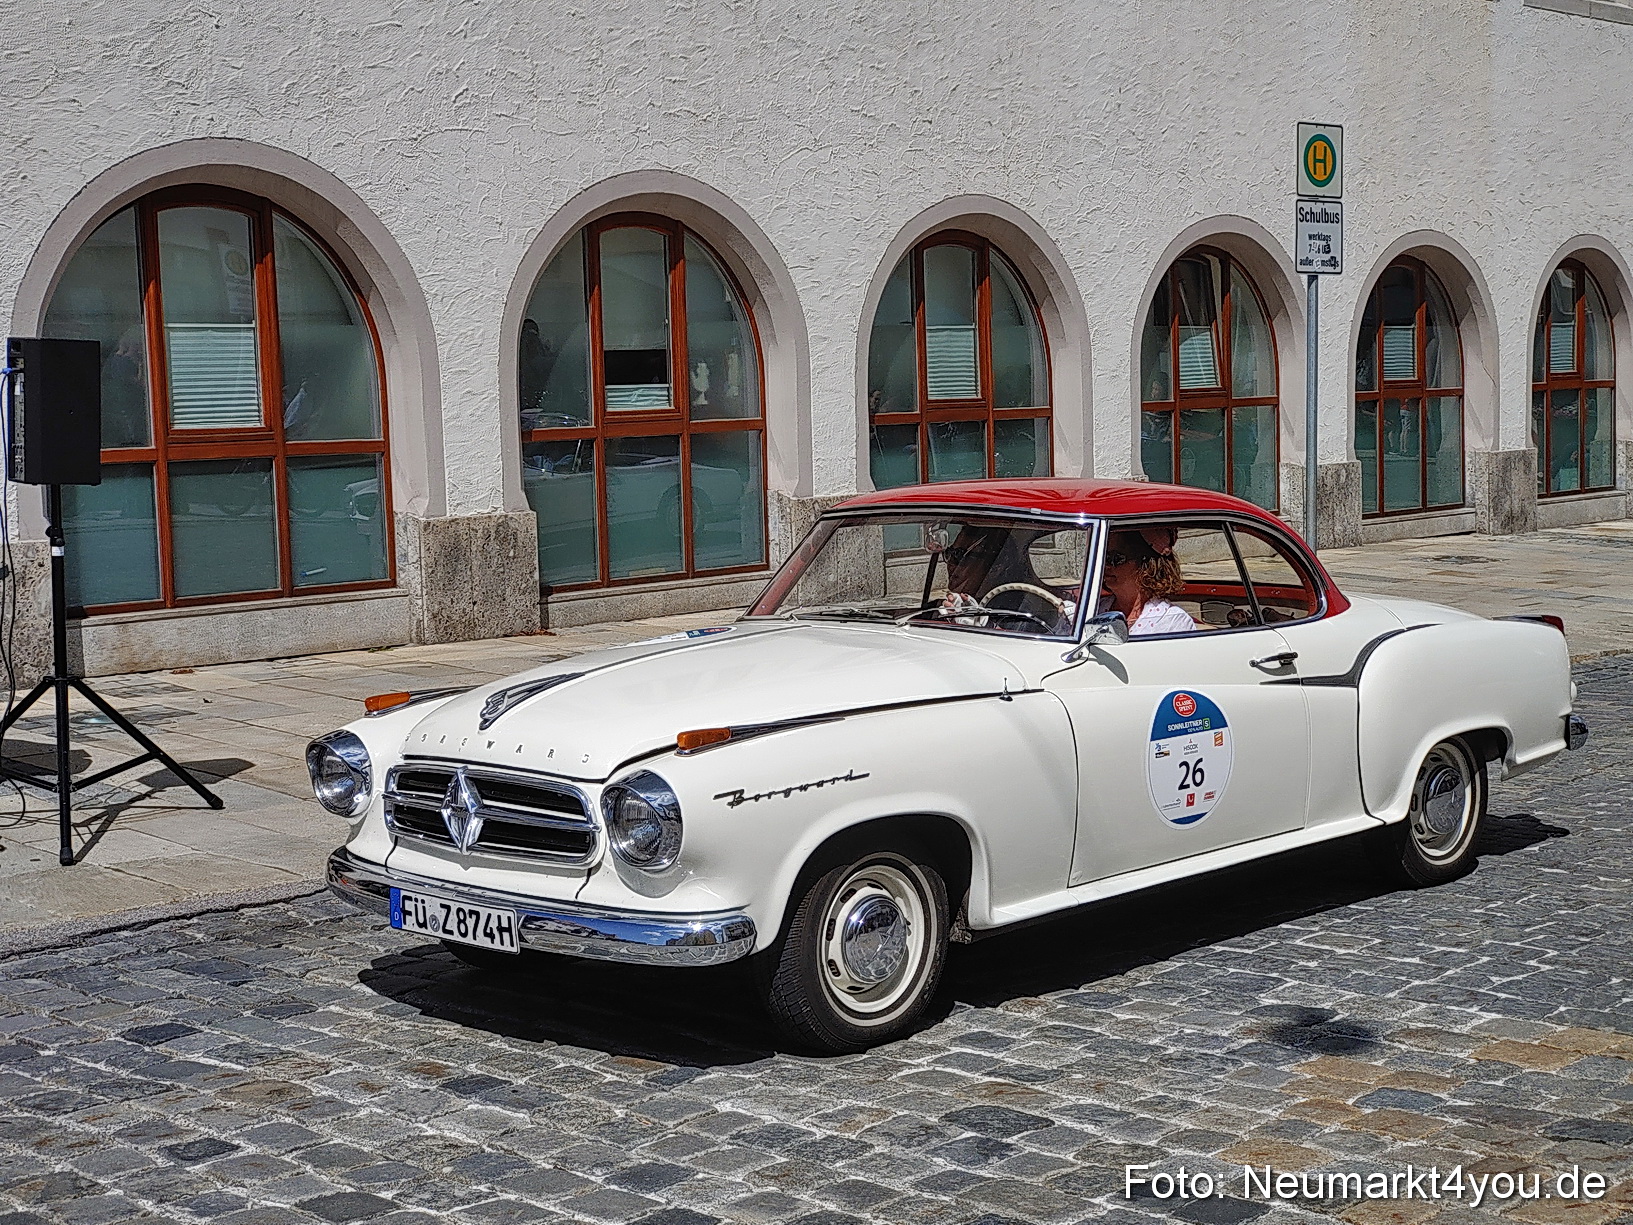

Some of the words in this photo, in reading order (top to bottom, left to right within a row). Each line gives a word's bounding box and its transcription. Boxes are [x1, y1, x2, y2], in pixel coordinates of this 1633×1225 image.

[1313, 145, 1328, 176] H
[1299, 206, 1340, 224] Schulbus
[1308, 231, 1332, 244] werktags
[1299, 256, 1314, 267] außer
[1167, 719, 1203, 732] SONNLEITNER
[1177, 757, 1205, 791] 26
[713, 769, 870, 809] Borgward
[394, 911, 400, 921] D
[401, 894, 428, 930] FÜ
[439, 903, 515, 947] Z874H
